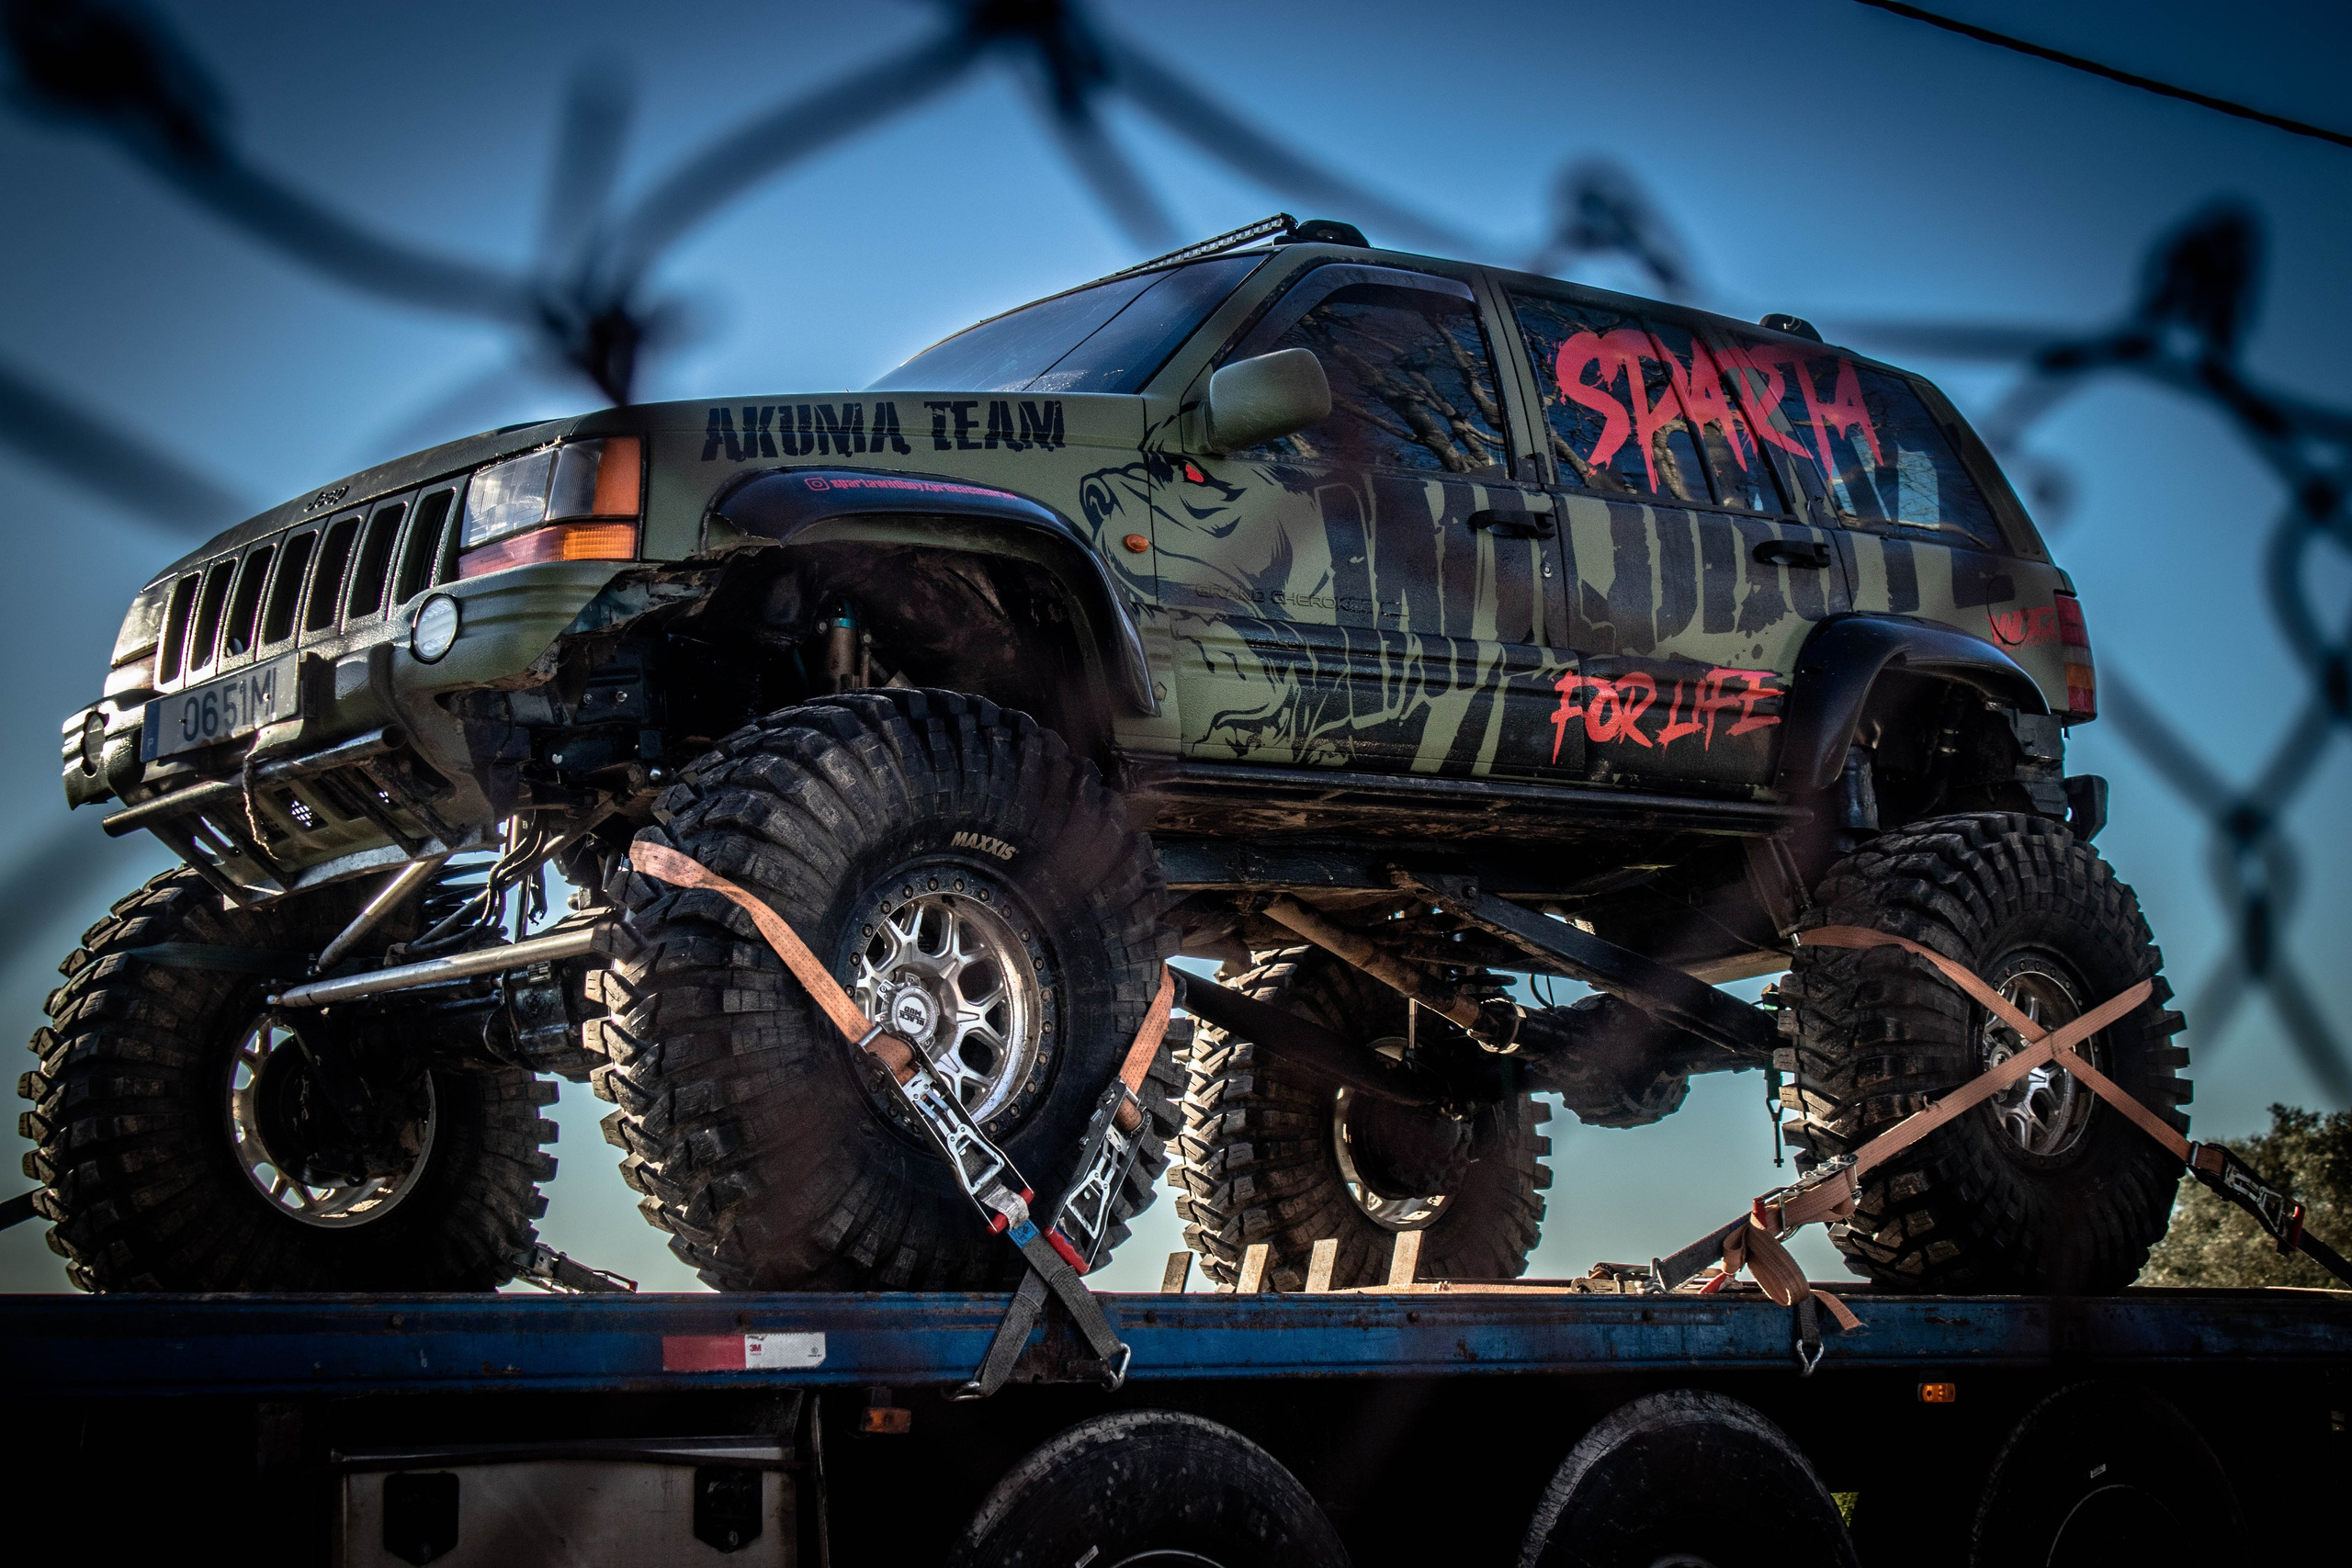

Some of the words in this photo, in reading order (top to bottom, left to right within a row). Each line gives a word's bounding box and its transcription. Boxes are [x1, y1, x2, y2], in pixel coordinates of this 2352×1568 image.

[1553, 329, 1884, 493] SPARTA
[701, 402, 911, 462] AKUMA
[924, 400, 1067, 452] TEAM
[304, 485, 350, 513] Jeep
[1195, 585, 1265, 604] GRAND
[1271, 591, 1374, 614] CHEROK
[1551, 670, 1657, 765] FOR
[1656, 666, 1785, 757] LIFE
[950, 831, 1016, 861] MAXXIS
[899, 1011, 926, 1027] BLACK
[904, 1006, 922, 1018] MUD
[750, 1344, 762, 1352] 3M
